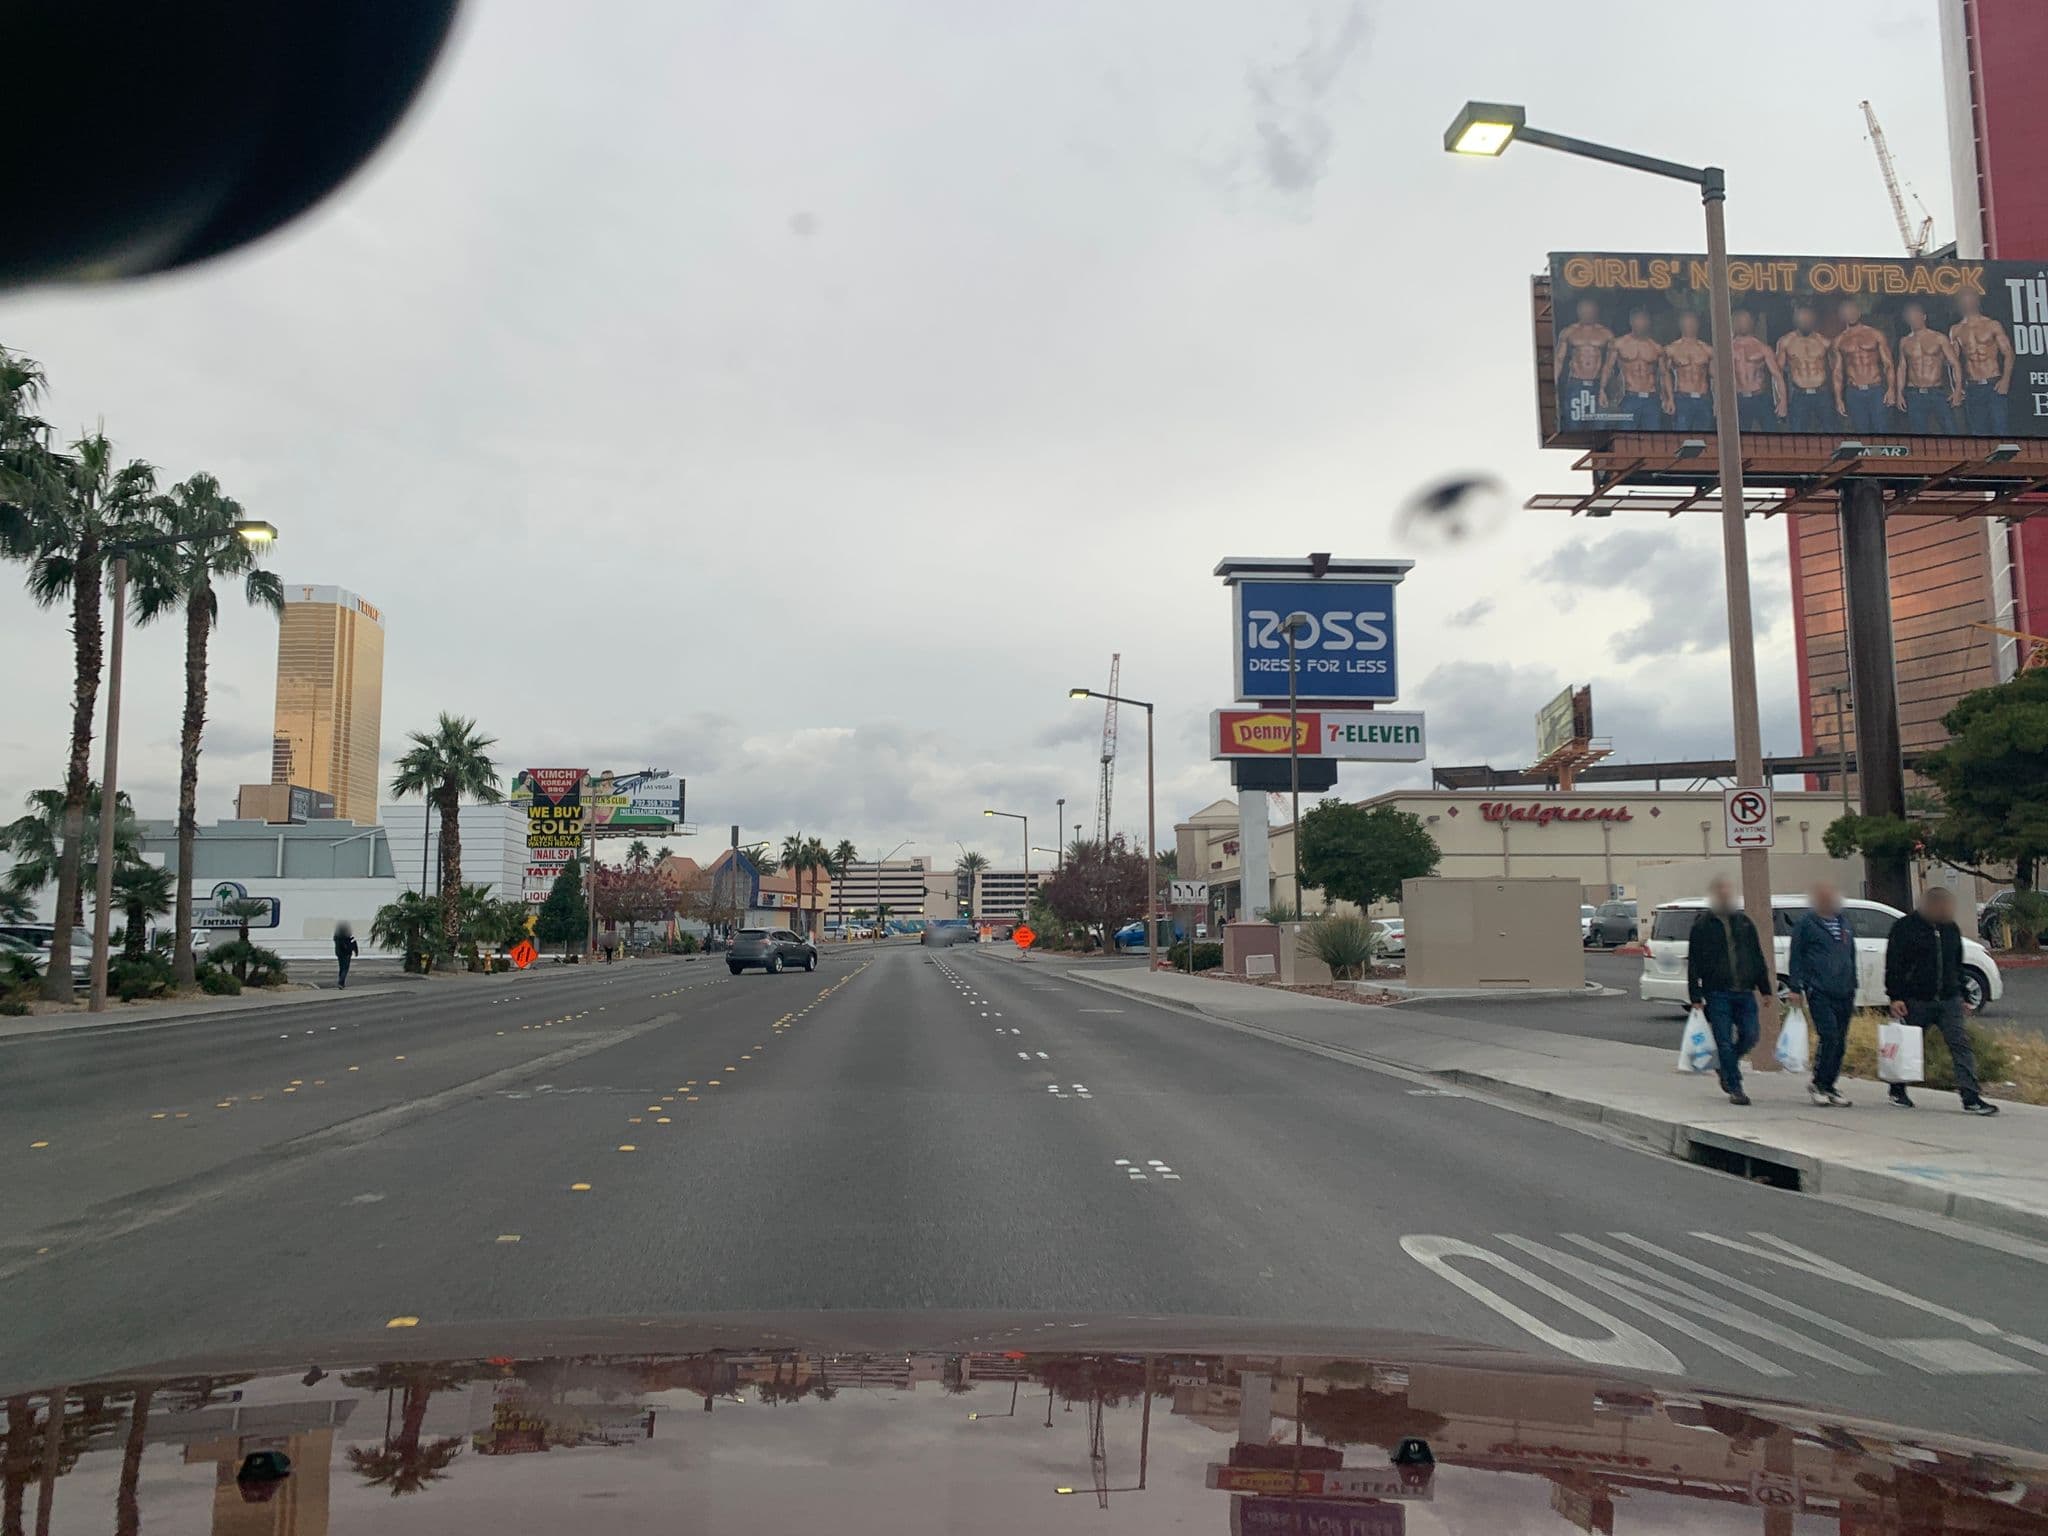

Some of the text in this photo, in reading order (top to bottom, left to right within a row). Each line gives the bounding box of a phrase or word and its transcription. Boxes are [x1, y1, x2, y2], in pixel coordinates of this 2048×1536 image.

[1564, 258, 1986, 295] GIRLS' NGHT OUTBACK
[1248, 610, 1387, 650] ROSS
[1250, 659, 1387, 673] DRESS FOR LESS
[1240, 725, 1303, 742] Dennys
[537, 770, 577, 779] KIMCHI
[611, 797, 627, 805] CLUB
[528, 807, 581, 818] WE BUY
[1480, 803, 1633, 826] Walgreens
[527, 820, 583, 835] GOLD
[537, 849, 556, 860] NAIL
[557, 849, 575, 860] SPA
[1399, 1232, 2048, 1376] ONLY
